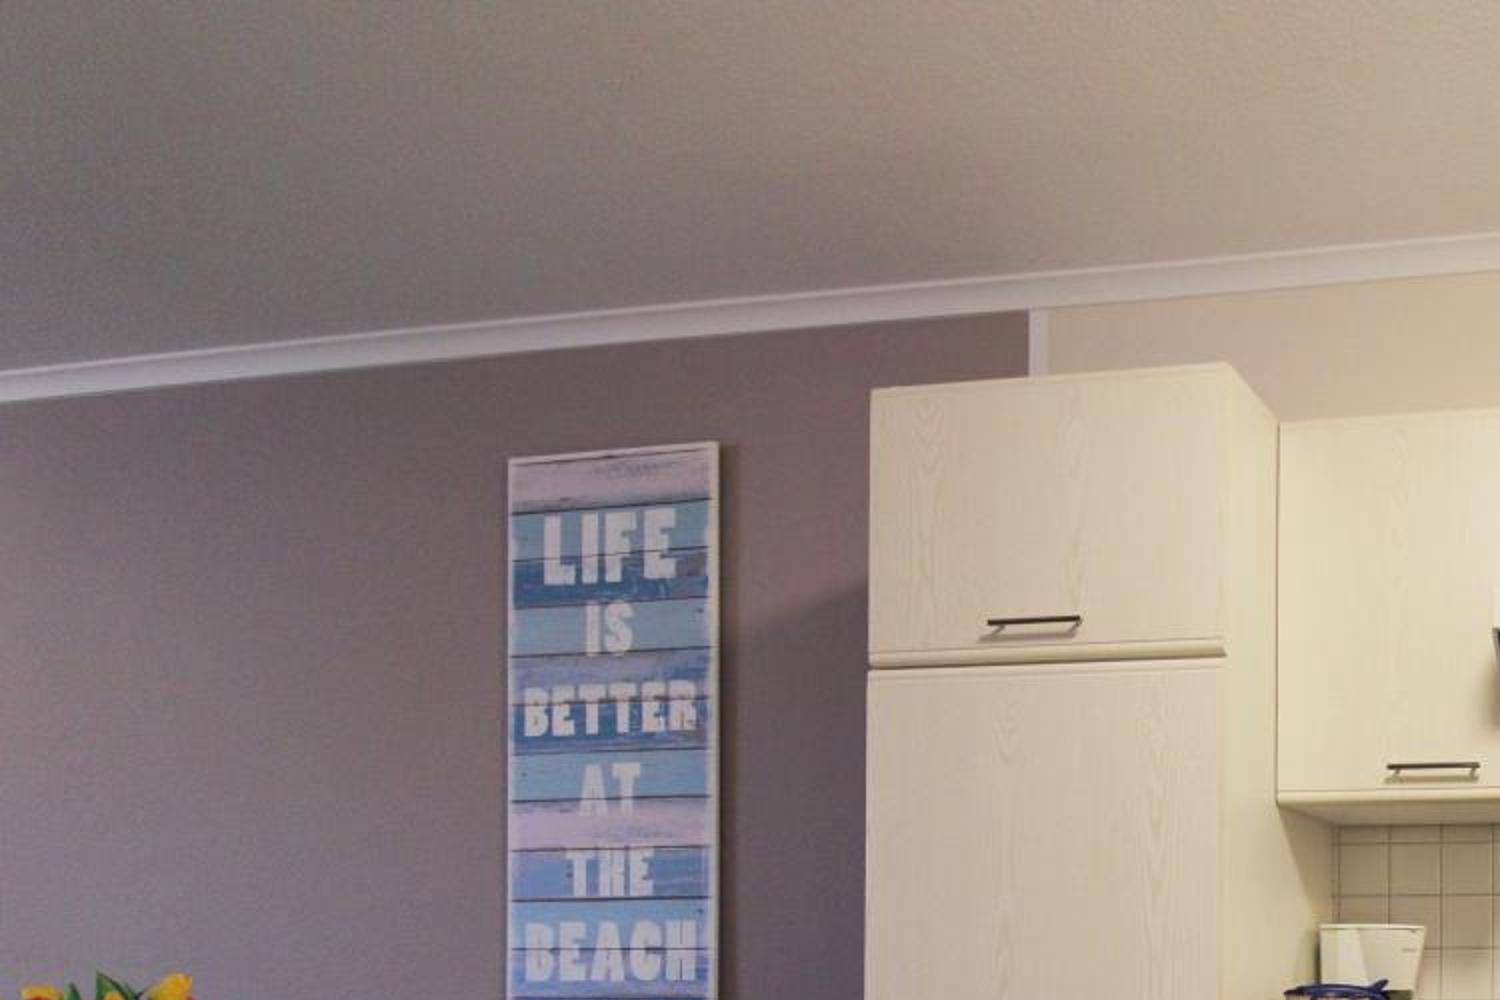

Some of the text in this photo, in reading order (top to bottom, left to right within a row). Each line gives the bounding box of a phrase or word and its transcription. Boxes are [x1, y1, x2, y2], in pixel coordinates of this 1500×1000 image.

[543, 508, 677, 586] LIFE
[585, 601, 634, 656] IS
[523, 680, 697, 737] BETTER
[579, 762, 641, 817] AT
[565, 847, 655, 898] THE
[525, 919, 697, 982] BEACH
